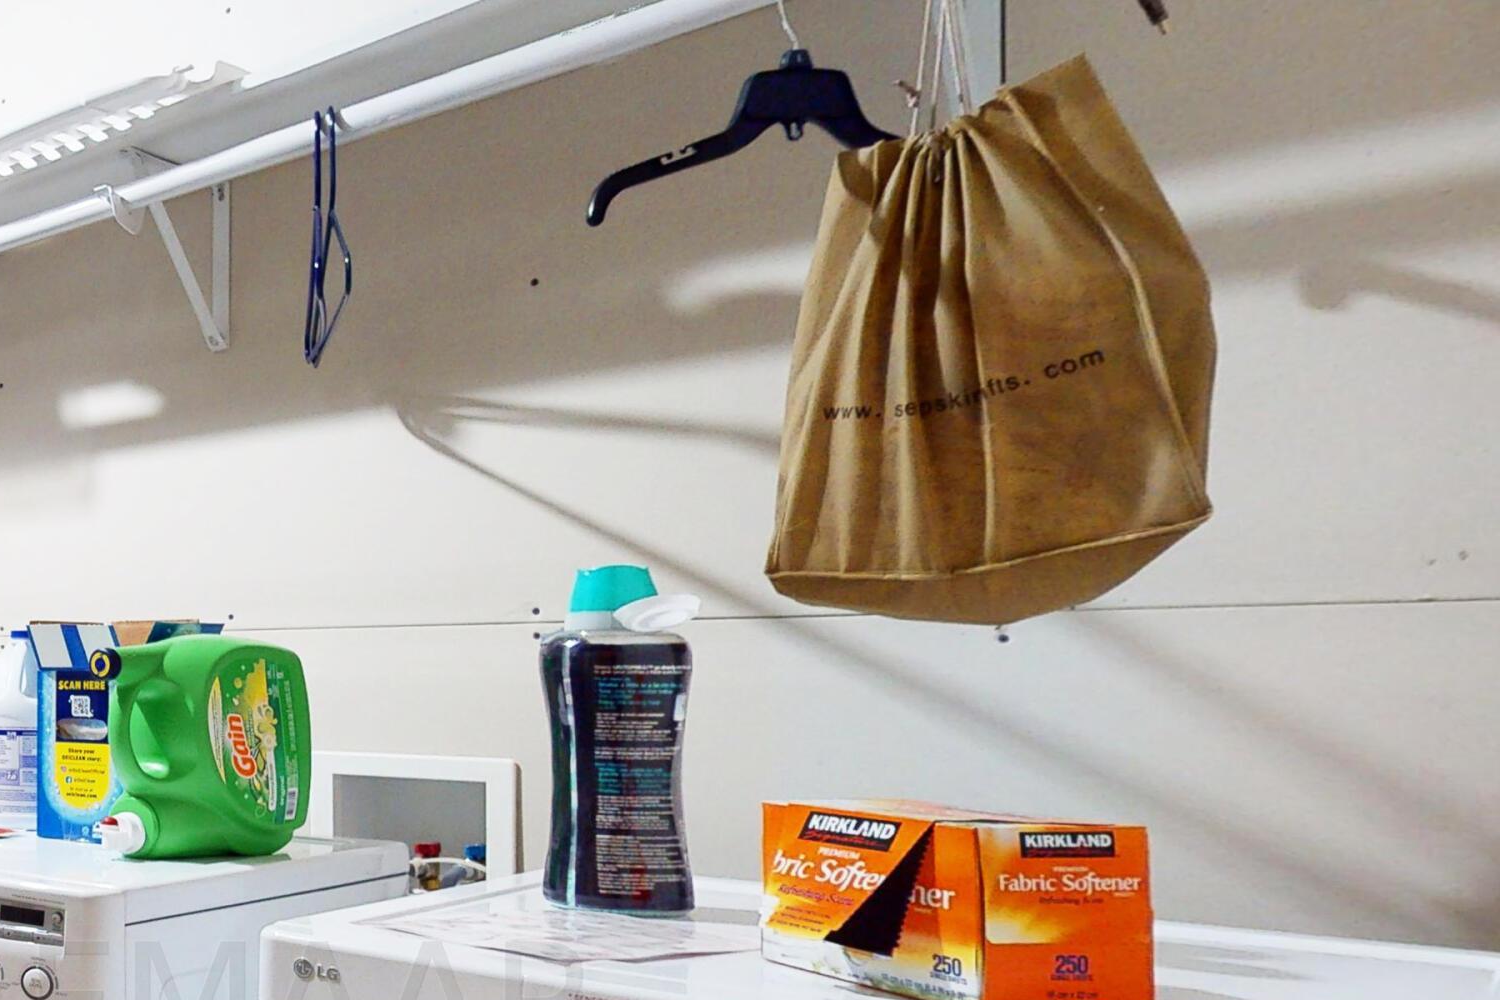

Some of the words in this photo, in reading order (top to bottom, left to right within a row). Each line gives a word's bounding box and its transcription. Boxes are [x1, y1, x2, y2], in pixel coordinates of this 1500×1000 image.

[1044, 349, 1105, 380] com
[58, 679, 81, 690] SCAN
[83, 680, 105, 690] HERE
[226, 712, 258, 779] Gain
[808, 813, 897, 840] KIRKLAND
[1025, 833, 1112, 848] KIRKLAND
[997, 873, 1048, 892] Fabric
[1061, 872, 1142, 895] Softener
[932, 953, 962, 977] 250
[1055, 955, 1088, 974] 250
